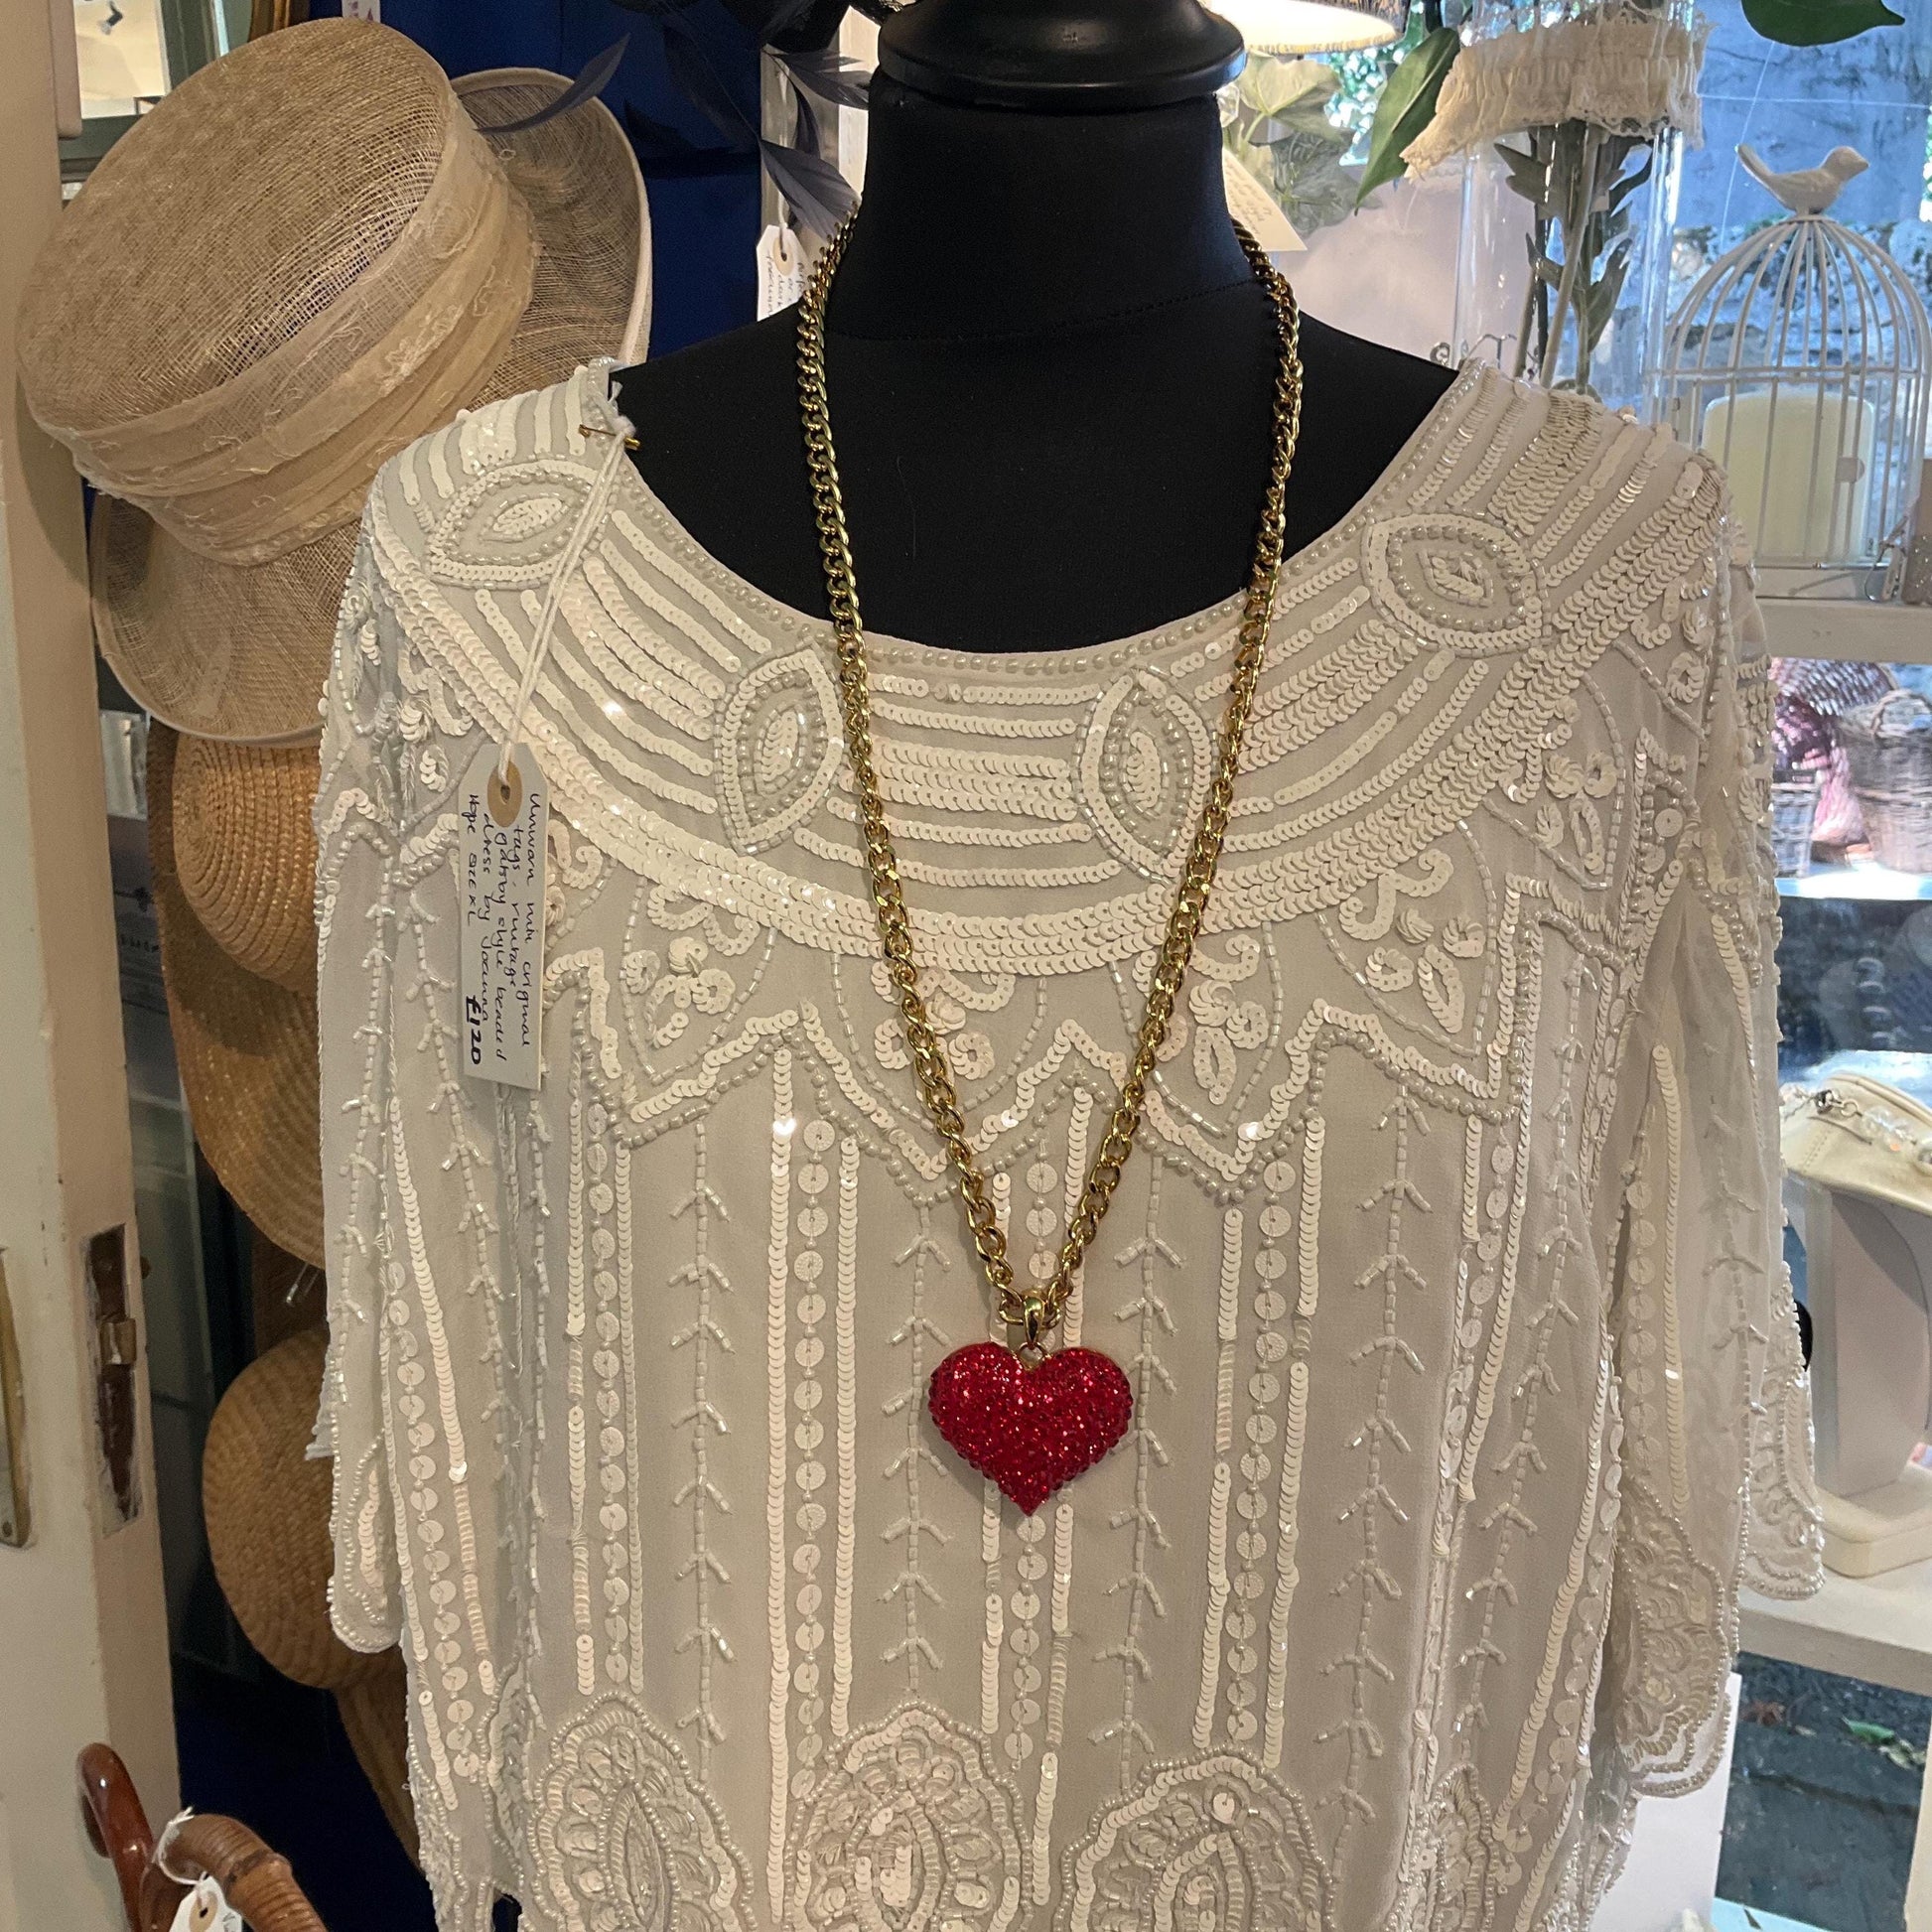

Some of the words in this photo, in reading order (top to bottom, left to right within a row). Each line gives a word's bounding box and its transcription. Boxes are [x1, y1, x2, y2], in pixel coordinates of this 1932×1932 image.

[461, 794, 481, 834] Hope
[483, 813, 494, 875] dress
[526, 793, 542, 887] Unworn
[477, 894, 493, 920] by
[490, 917, 507, 969] style
[481, 936, 492, 1022] Joanna
[515, 961, 532, 1047] original
[466, 995, 483, 1065] £120
[494, 986, 507, 1061] beaded
